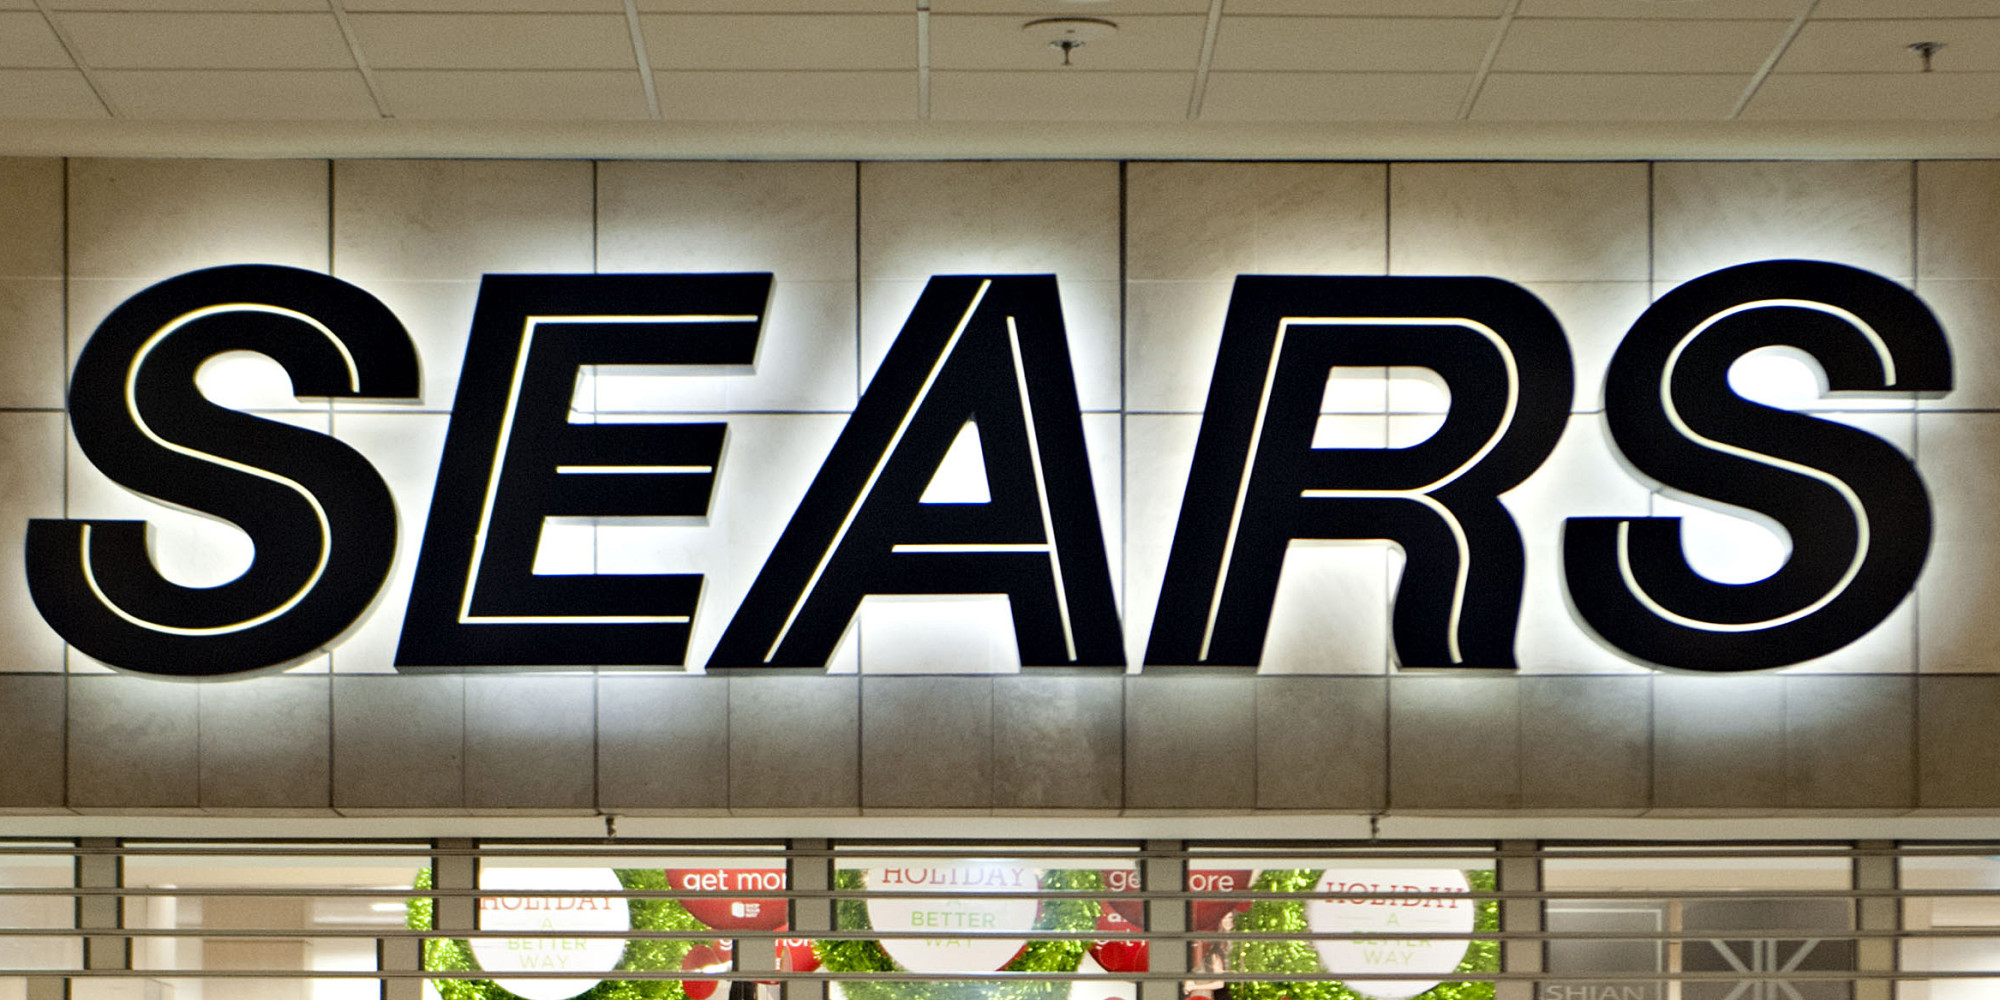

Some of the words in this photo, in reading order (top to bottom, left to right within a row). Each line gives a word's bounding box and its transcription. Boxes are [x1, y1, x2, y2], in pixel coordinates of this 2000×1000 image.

[25, 260, 1955, 676] SEARS
[683, 869, 729, 891] get
[1189, 873, 1235, 892] ore
[911, 911, 996, 928] BETTER
[519, 954, 570, 969] WAY
[1363, 950, 1414, 965] WAY
[1546, 985, 1645, 1000] SHIAN
